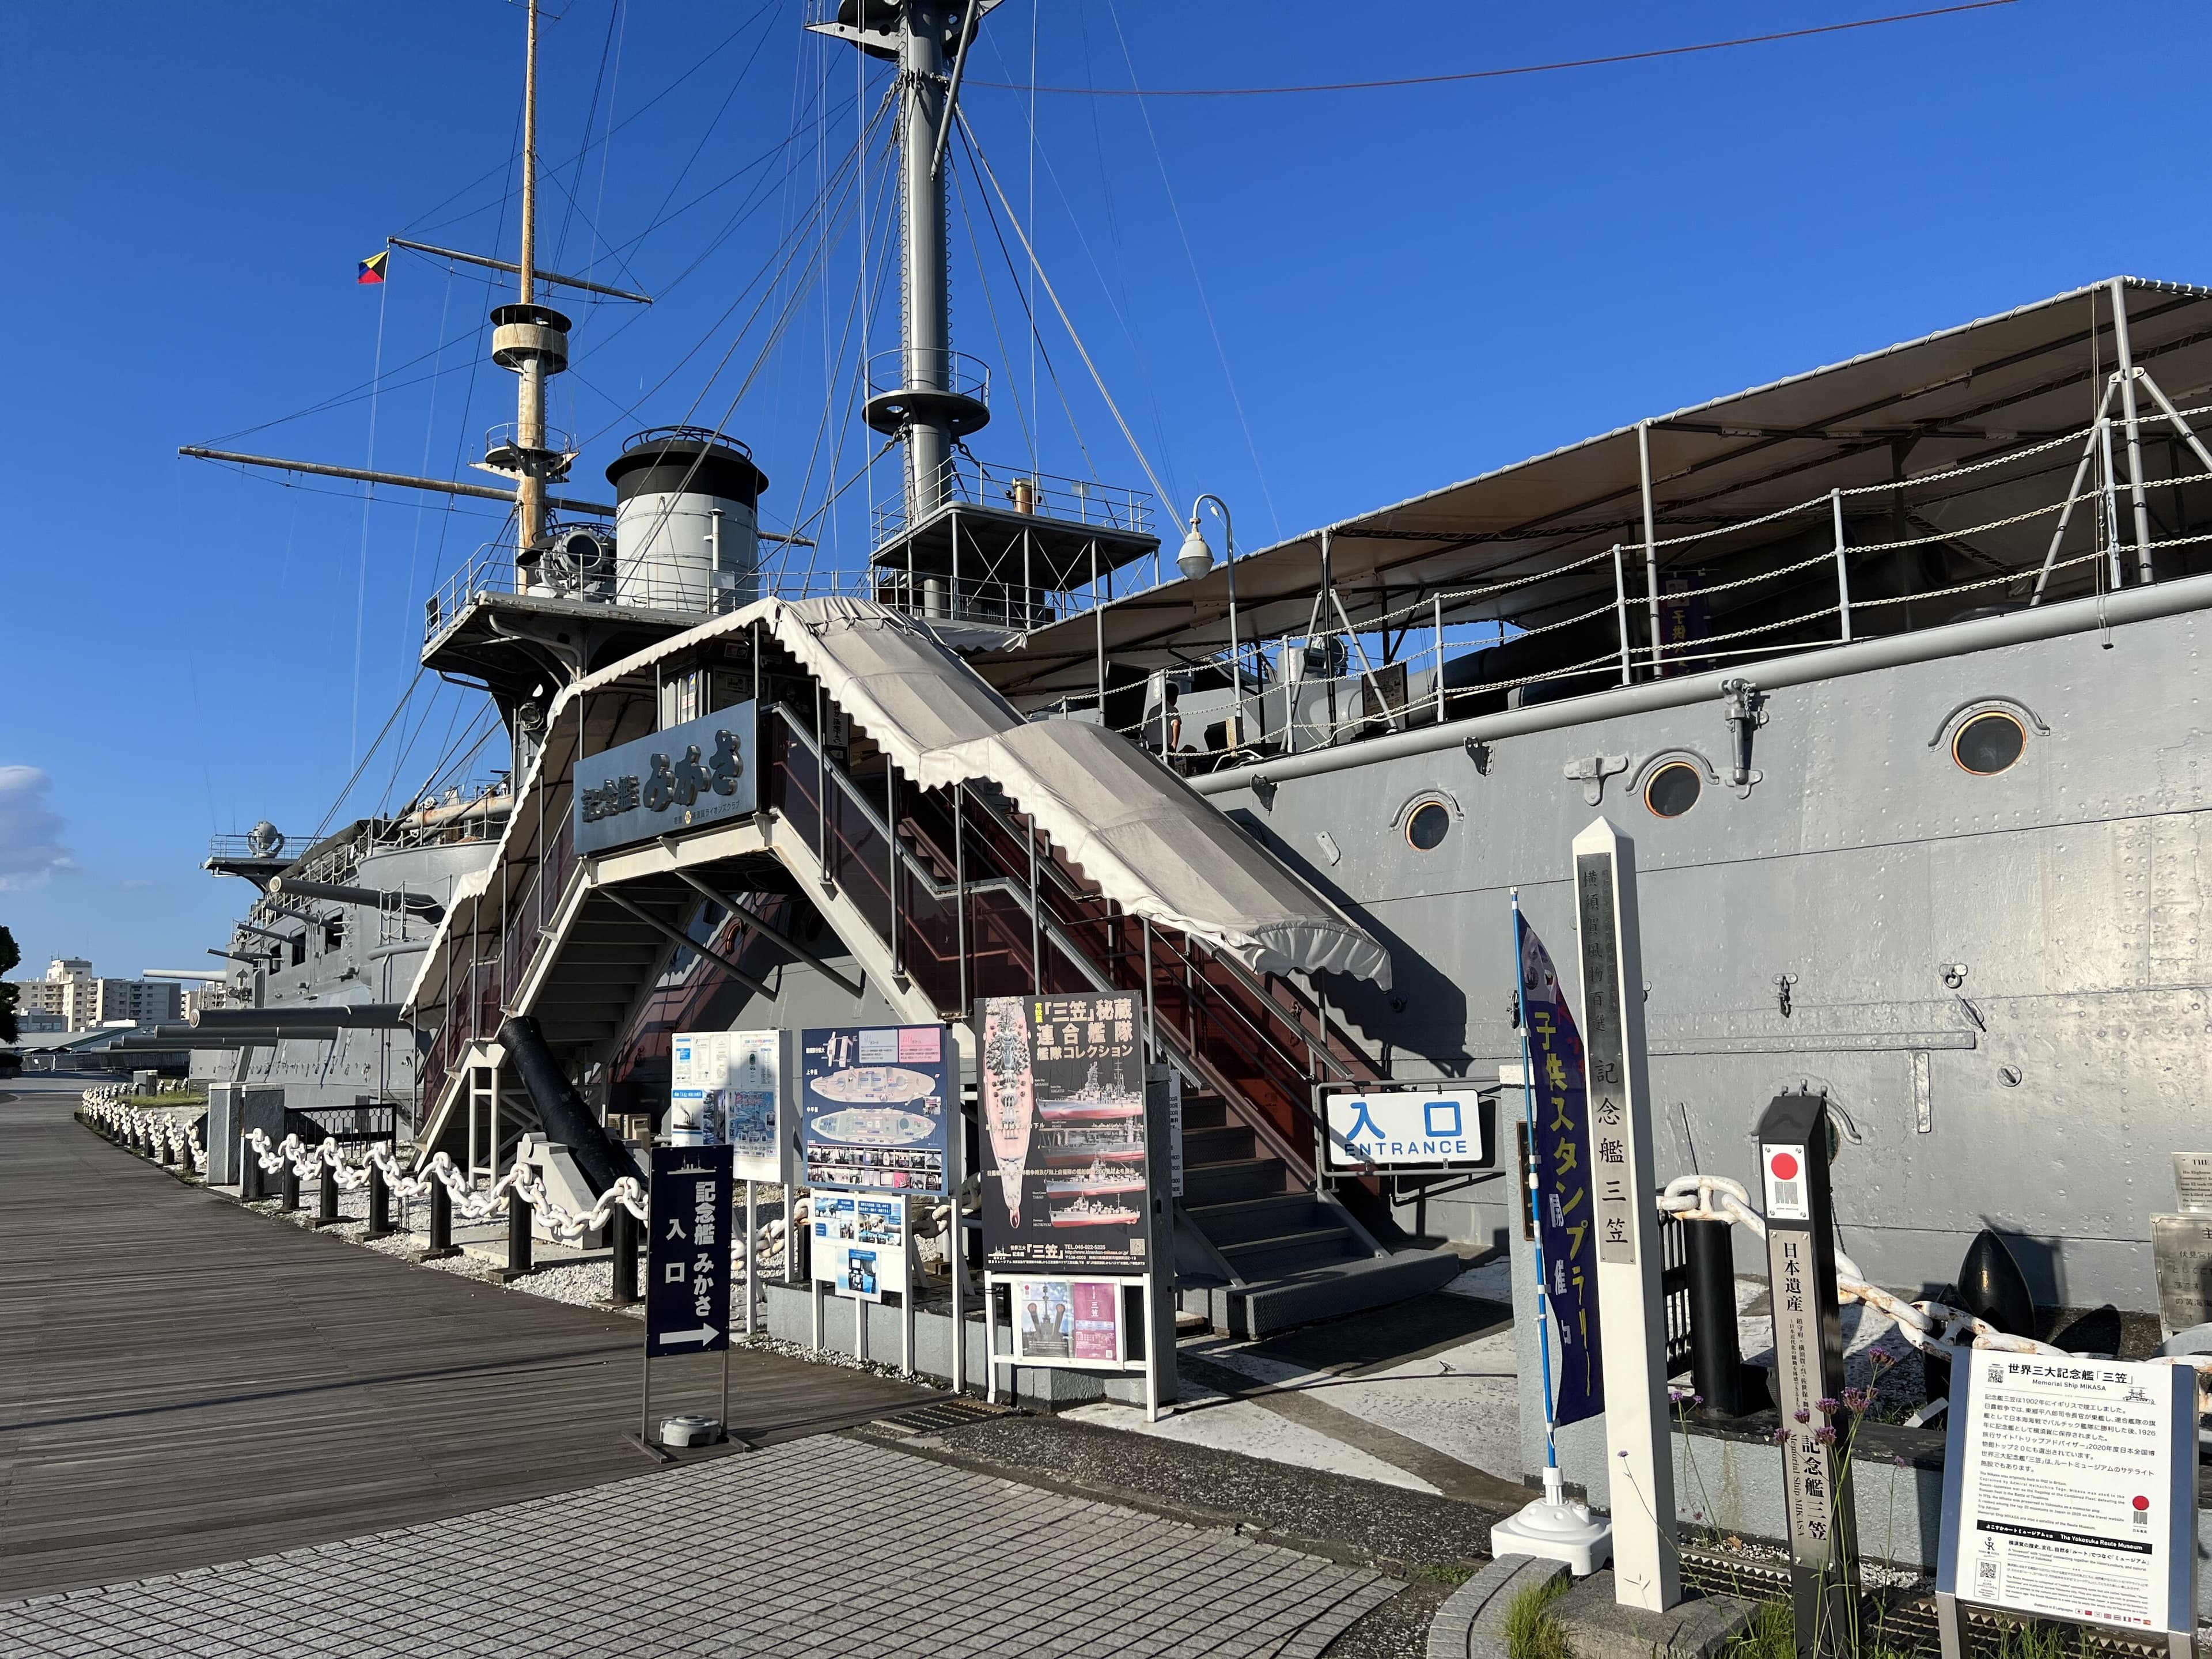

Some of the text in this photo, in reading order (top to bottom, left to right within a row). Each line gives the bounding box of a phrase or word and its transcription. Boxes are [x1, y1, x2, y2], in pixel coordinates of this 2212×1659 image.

[643, 730, 743, 812] みかさ
[1045, 998, 1132, 1022] 「三笠」秘蔵
[1037, 1021, 1133, 1045] 連合艦隊
[1037, 1044, 1133, 1060] 艦隊コレクション
[1584, 870, 1606, 1032] 横須賀風物百選
[1595, 1059, 1628, 1246] 記念艦三笠
[1344, 1141, 1467, 1156] ENTRANCE
[1535, 1012, 1590, 1396] 子供スタンプラリー
[665, 1219, 687, 1284] 入口
[694, 1181, 715, 1316] 記念艦 みかさ
[1784, 1242, 1803, 1312] 日本遺産
[2008, 1363, 2133, 1385] 世界三大記念艦「三笠」
[2032, 1378, 2106, 1391] Memorial Ship MIKASA
[1983, 1422, 2108, 1441] 年に記念艦として横須賀に保存されました。
[1980, 1460, 2034, 1472] 施設でもあります。
[1790, 1434, 1805, 1536] Memorial Ship MIKASA
[1801, 1435, 1827, 1541] 記念艦三笠
[2059, 1533, 2143, 1551] The Yokosuka Route Museum
